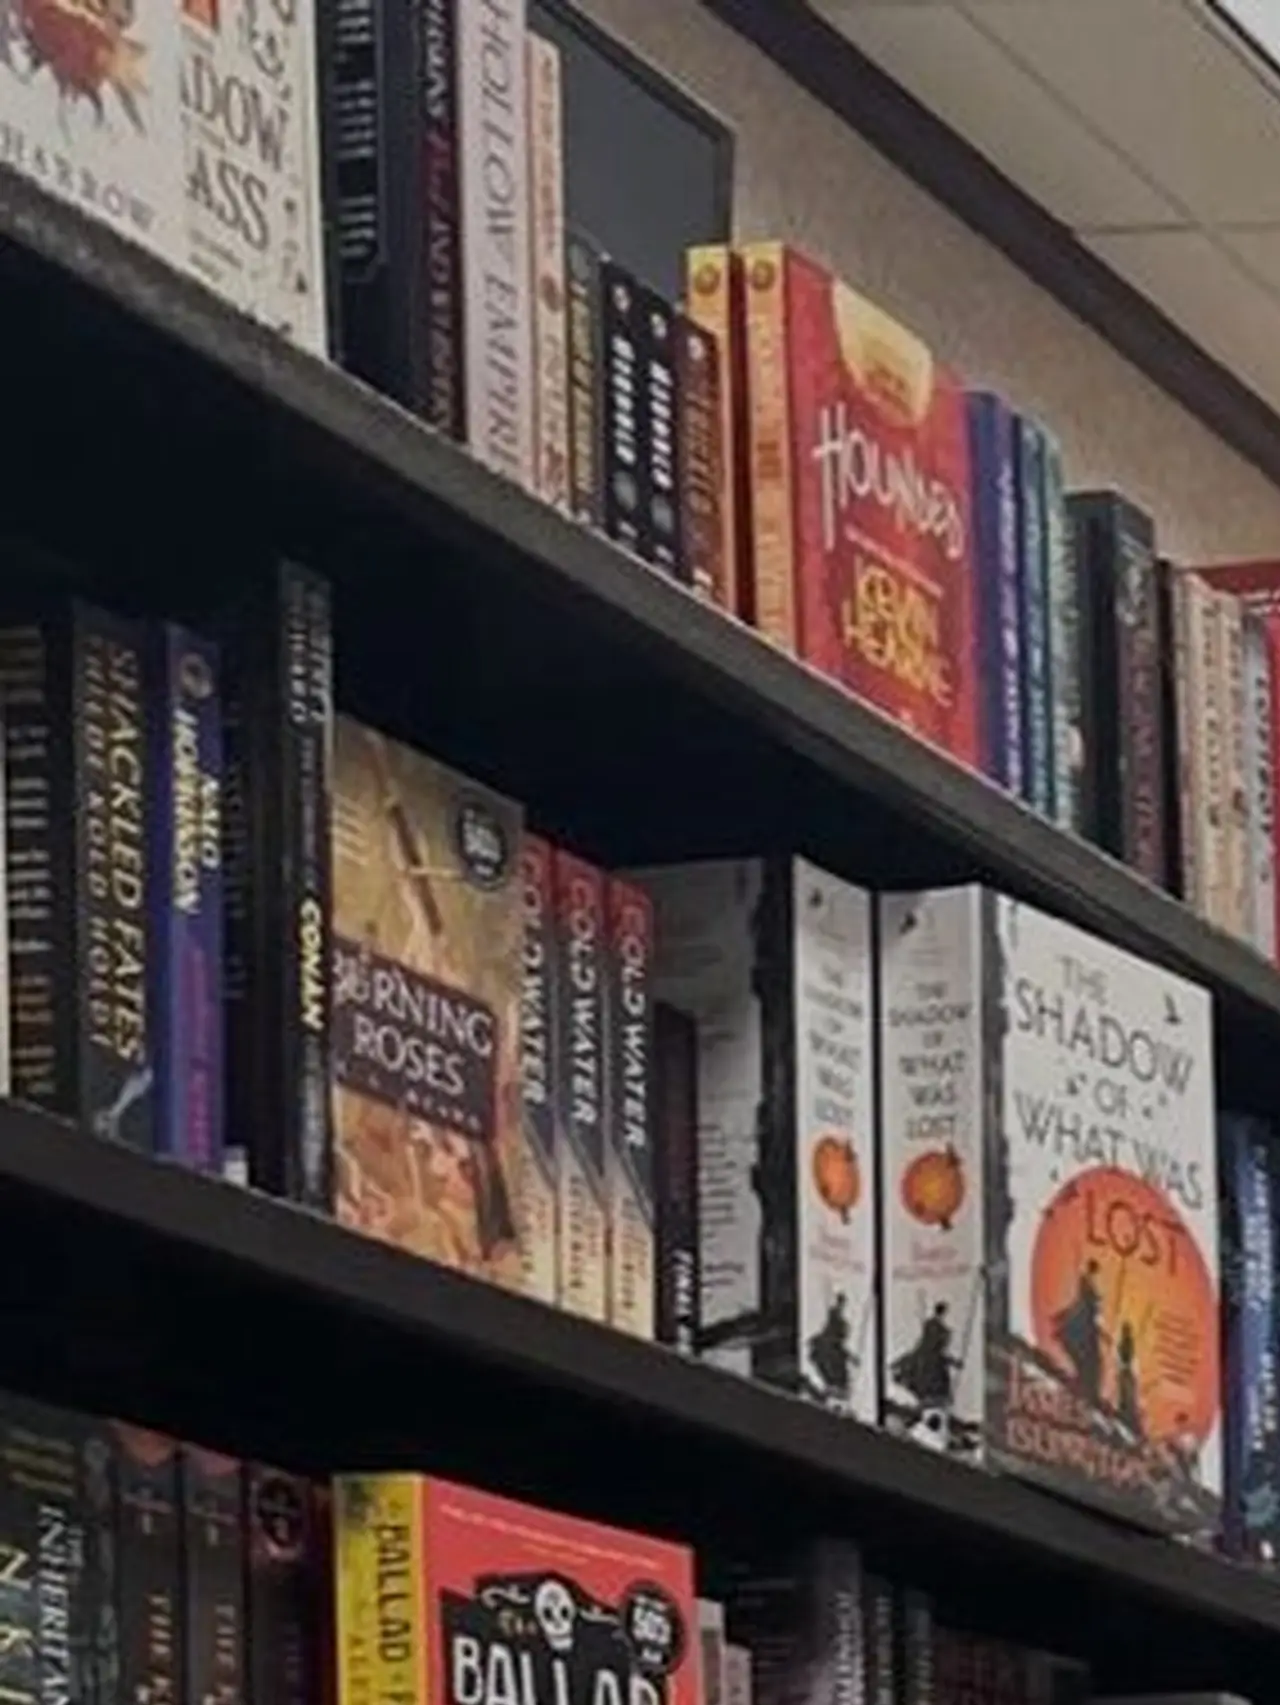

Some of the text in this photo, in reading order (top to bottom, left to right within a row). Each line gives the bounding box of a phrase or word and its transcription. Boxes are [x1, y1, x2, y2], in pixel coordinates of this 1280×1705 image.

[106, 645, 148, 1066] SHACKLED FATES
[171, 706, 201, 916] HOPKINSON
[200, 776, 222, 871] NALO
[299, 898, 326, 1031] CONAN
[1060, 956, 1110, 994] THE
[353, 1014, 466, 1096] ROSES
[898, 1052, 967, 1076] WHAT
[1013, 978, 1194, 1095] SHADOW
[905, 1114, 960, 1141] LOST
[907, 1082, 957, 1106] WAS
[1097, 1079, 1138, 1118] OF
[1013, 1087, 1202, 1210] WHAT WAS
[1083, 1189, 1184, 1280] LOST
[147, 1594, 171, 1661] THE
[375, 1521, 412, 1666] BALLAD
